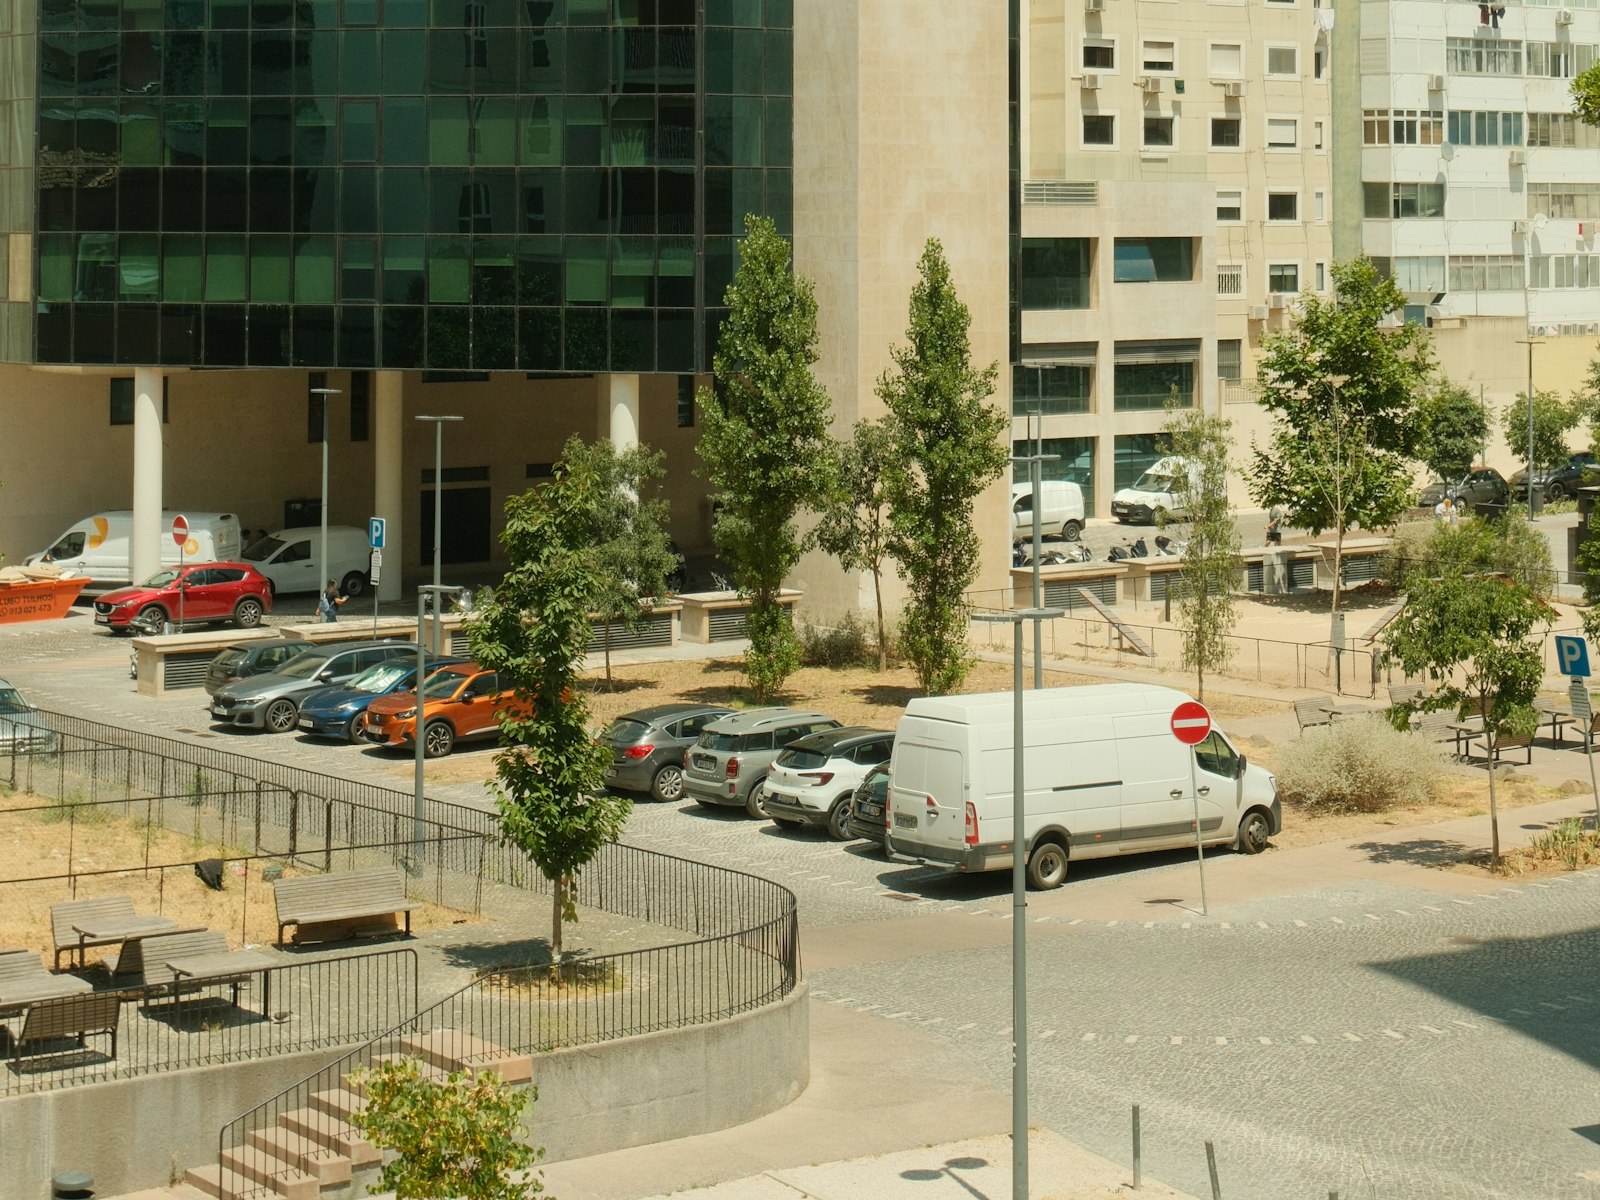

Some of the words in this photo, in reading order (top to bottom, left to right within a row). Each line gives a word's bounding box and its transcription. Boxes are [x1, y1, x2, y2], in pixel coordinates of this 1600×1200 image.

[372, 521, 381, 545] P
[23, 594, 53, 603] TULHOS
[1560, 639, 1581, 673] P
